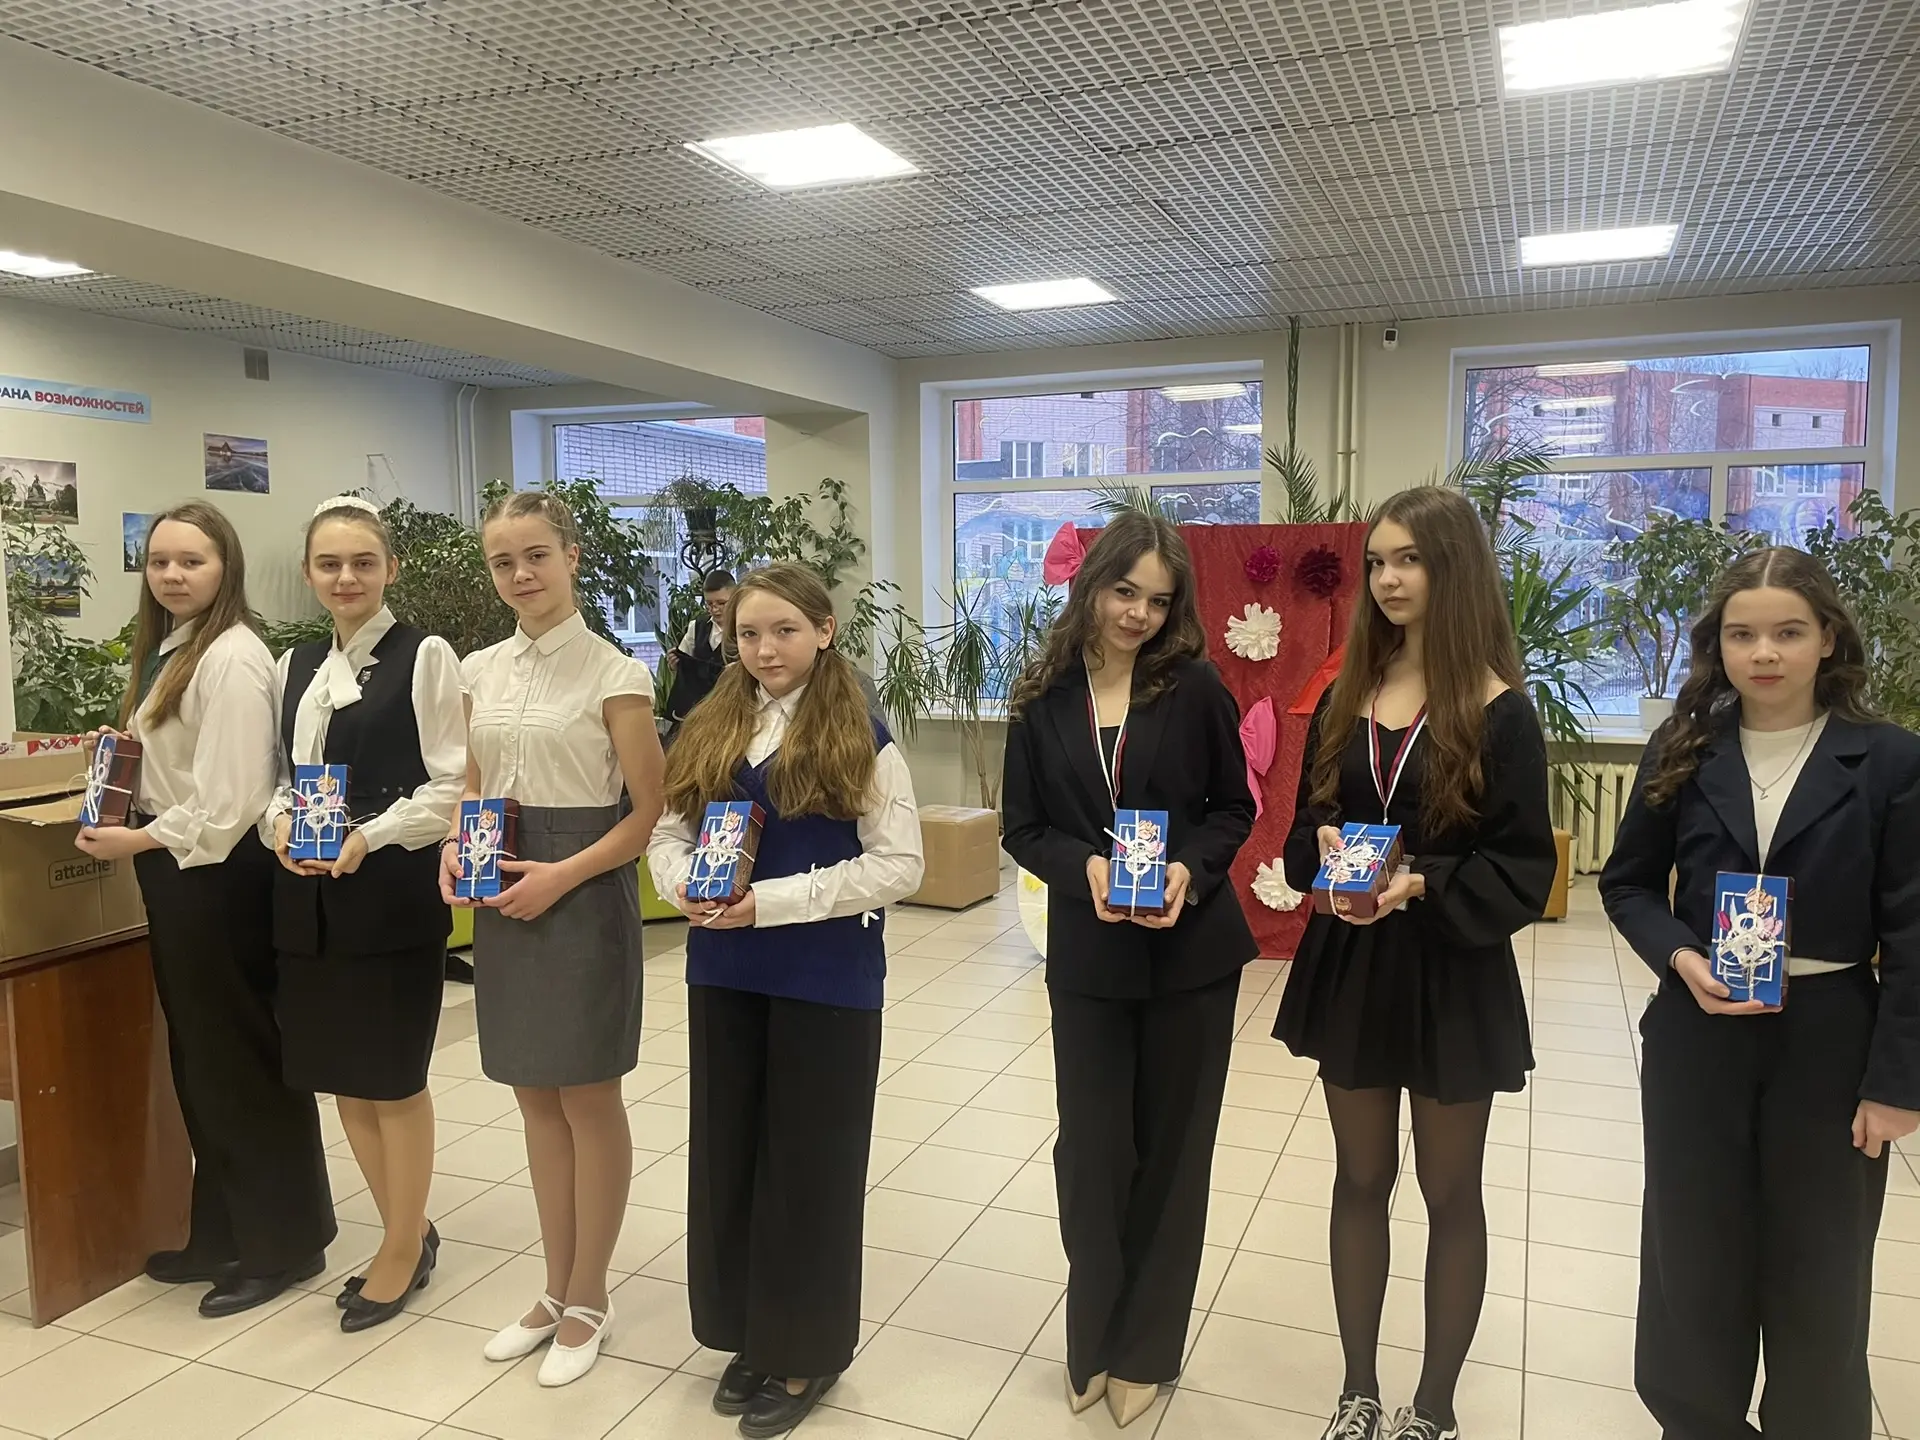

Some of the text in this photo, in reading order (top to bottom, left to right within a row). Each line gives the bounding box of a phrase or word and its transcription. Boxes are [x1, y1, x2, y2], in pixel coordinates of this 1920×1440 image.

[0, 387, 145, 415] АНА ВОЗМОЖНОСТЕЙ
[54, 858, 111, 881] attache
